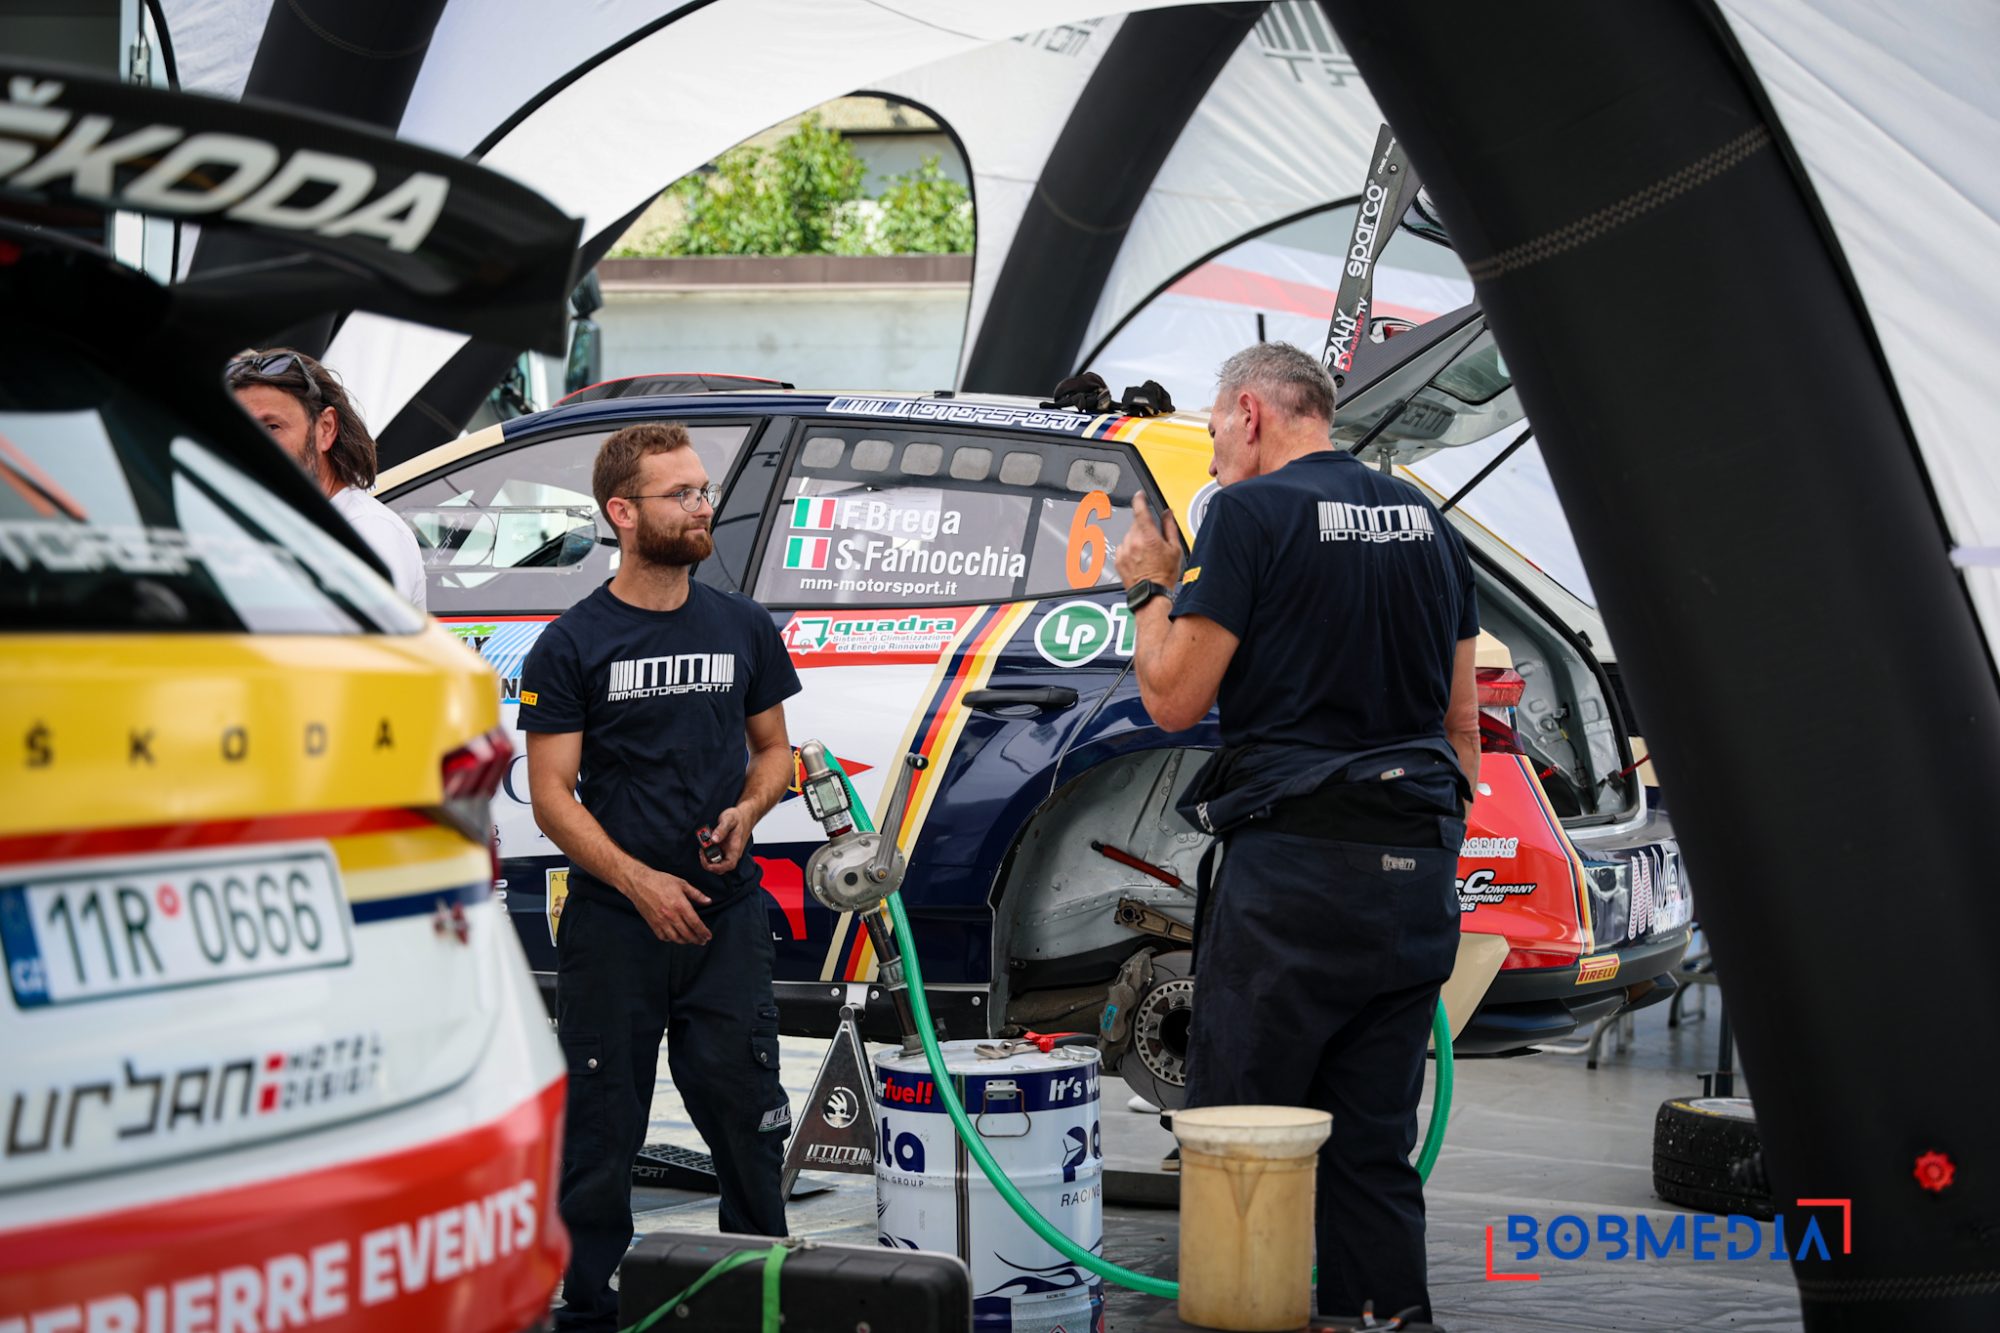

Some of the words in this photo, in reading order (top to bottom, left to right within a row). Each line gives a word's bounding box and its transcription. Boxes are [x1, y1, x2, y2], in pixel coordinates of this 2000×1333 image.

[1347, 184, 1383, 277] sparco
[840, 499, 962, 540] F.Brega
[1066, 489, 1112, 590] 6
[1319, 529, 1435, 543] MOTORSPORT
[834, 539, 1027, 578] S.Farnocchia
[799, 576, 958, 597] mm-motorsport.it
[832, 635, 868, 643] Sistemi
[879, 633, 952, 642] Climatizzazione
[833, 617, 955, 636] quadra
[837, 643, 850, 651] ed
[888, 642, 940, 650] Rinnovabili
[47, 886, 165, 985] 11R
[188, 869, 323, 965] 0666
[1049, 1077, 1082, 1101] It's
[891, 1175, 924, 1188] GROUP
[361, 1177, 537, 1305] EVENTS
